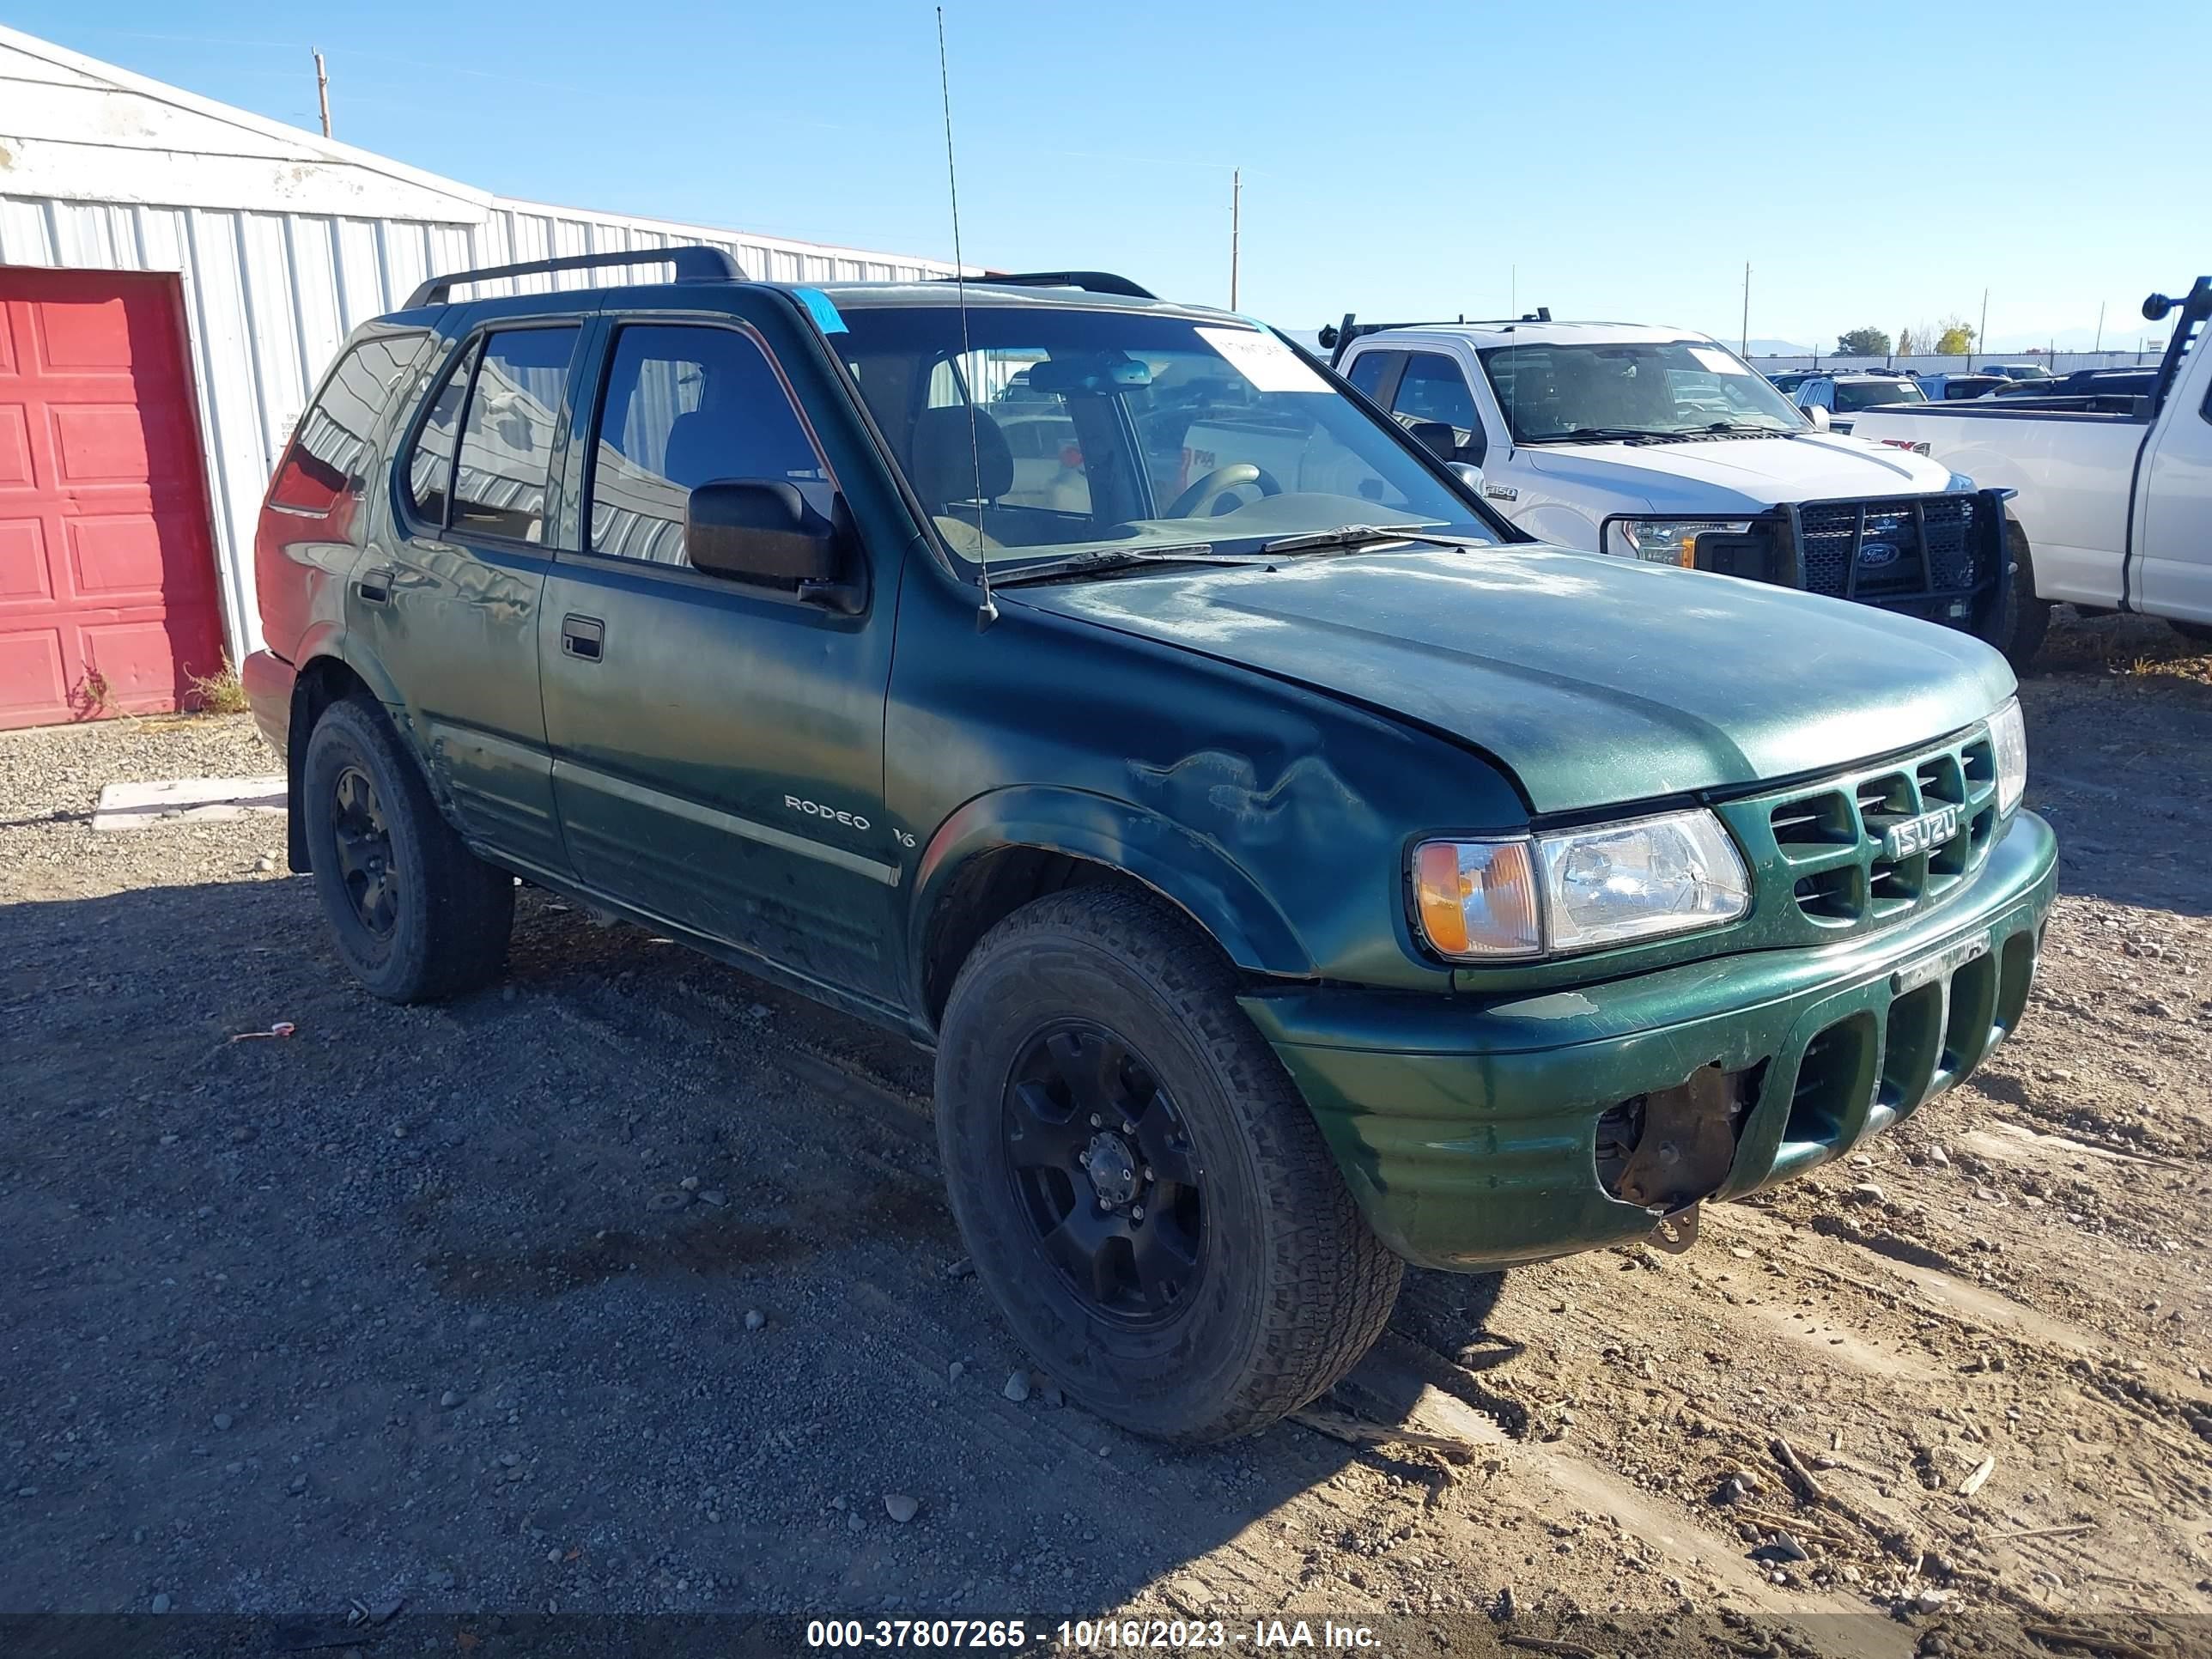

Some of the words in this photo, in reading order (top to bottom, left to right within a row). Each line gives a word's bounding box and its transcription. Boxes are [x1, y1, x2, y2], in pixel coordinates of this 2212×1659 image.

[1864, 549, 1890, 562] Ford
[784, 794, 871, 830] RODEO
[893, 827, 916, 848] V6
[1893, 808, 1957, 858] ISUZU
